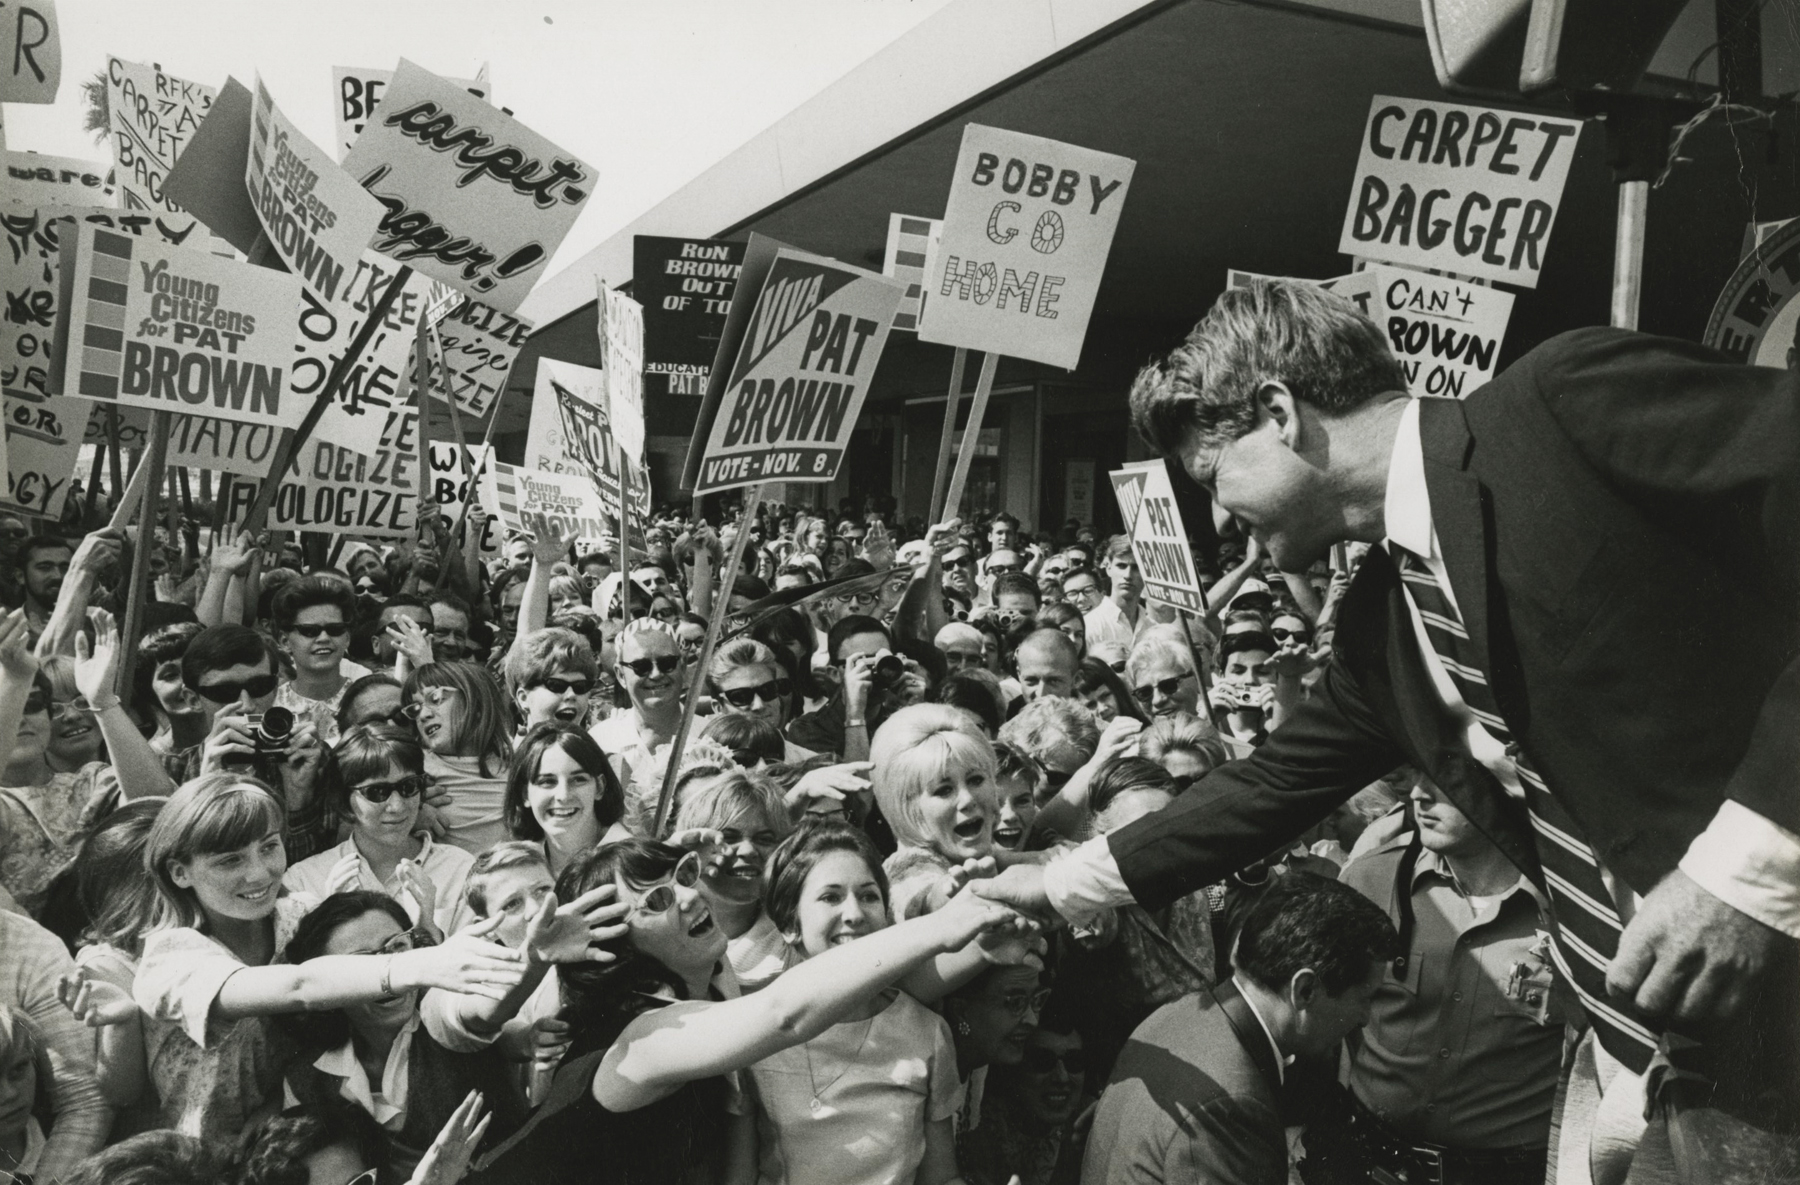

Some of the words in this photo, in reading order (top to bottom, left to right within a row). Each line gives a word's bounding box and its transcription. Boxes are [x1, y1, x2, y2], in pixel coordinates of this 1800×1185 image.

[274, 123, 319, 192] Young
[1369, 105, 1576, 182] CARPET
[275, 153, 338, 228] Citizens
[971, 152, 1122, 215] BOBBY
[283, 183, 326, 236] PAT
[987, 201, 1064, 254] GO
[1352, 175, 1553, 271] BAGGER
[260, 172, 345, 302] BROWN
[140, 258, 219, 307] Young
[662, 295, 692, 311] OF
[703, 298, 733, 315] TO
[941, 255, 1066, 319] HOME
[136, 317, 168, 337] for
[174, 321, 246, 354] PAT
[151, 292, 256, 335] Citizens
[749, 274, 824, 365] VIVA
[799, 309, 879, 376] PAT
[1387, 316, 1497, 371] ROWN
[121, 340, 282, 416] BROWN
[668, 373, 693, 394] PAT
[1425, 364, 1467, 397] ON
[722, 376, 855, 448] BROWN
[170, 413, 273, 463] MAYO
[813, 453, 828, 473] 8
[314, 441, 418, 488] OGIZE
[519, 475, 561, 495] Young
[527, 489, 583, 506] Citizens
[541, 502, 579, 515] PAT
[1144, 497, 1177, 537] PAT
[519, 510, 607, 539] BOWN
[1135, 540, 1192, 586] BROWN
